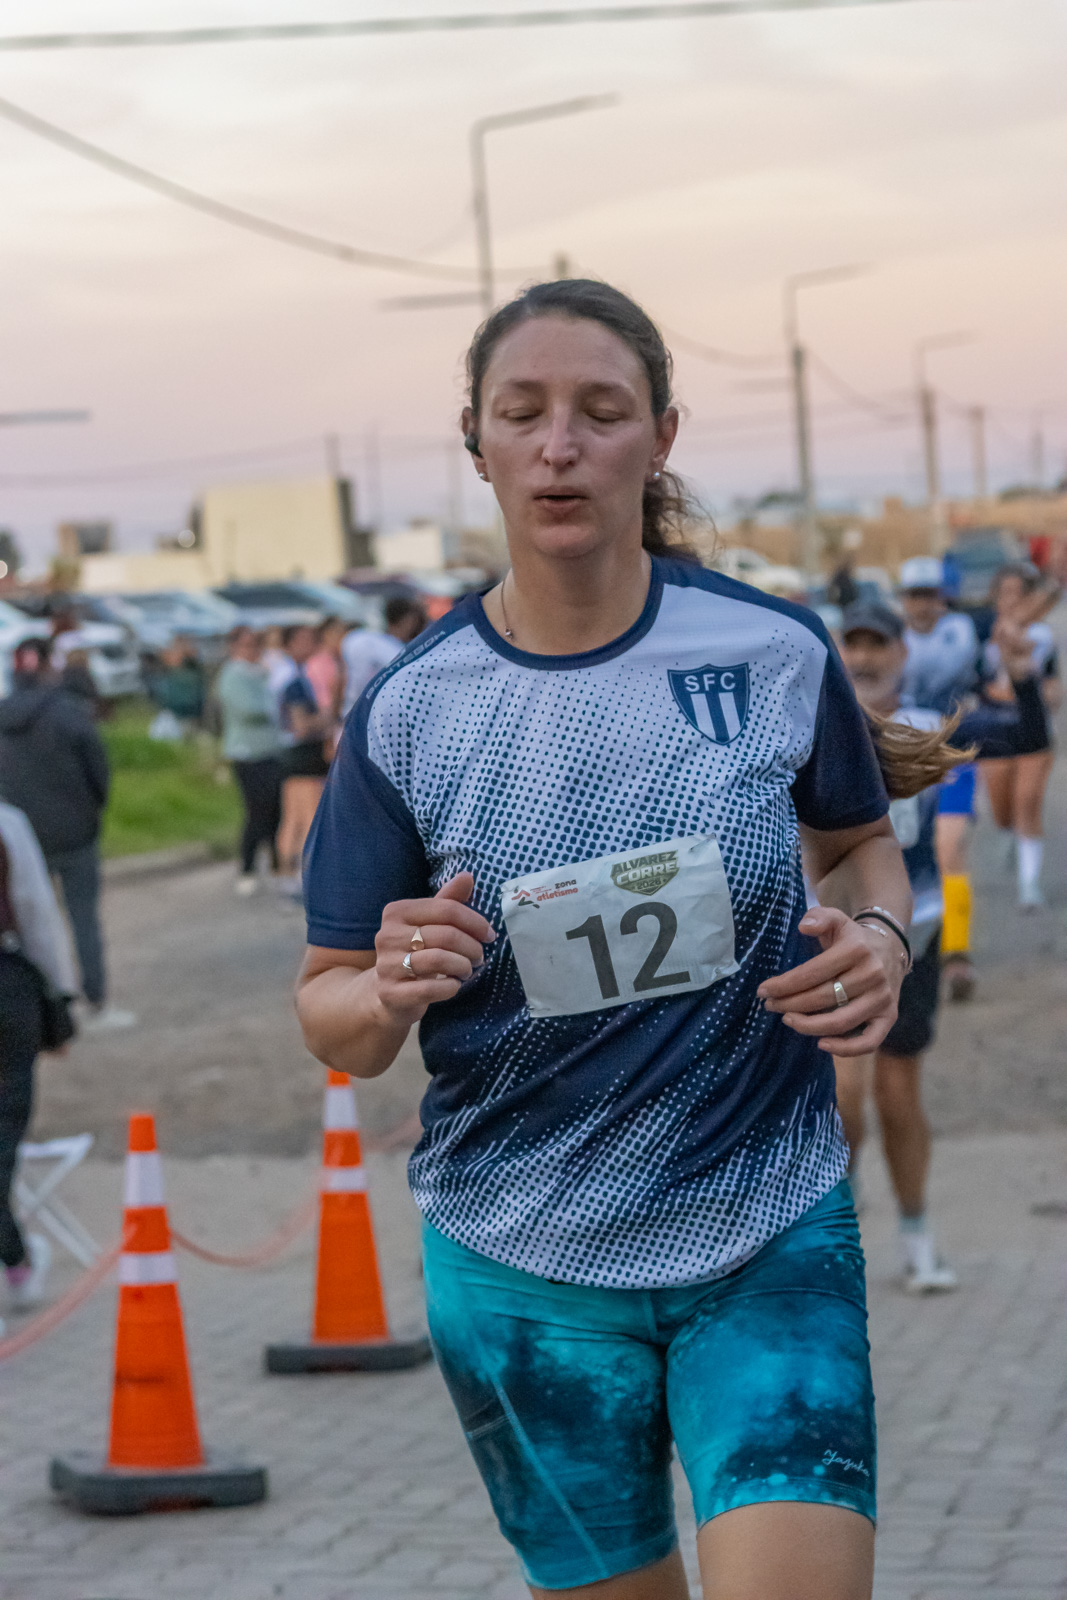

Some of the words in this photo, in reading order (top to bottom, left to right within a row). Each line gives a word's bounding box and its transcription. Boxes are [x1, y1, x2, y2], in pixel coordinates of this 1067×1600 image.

[684, 671, 736, 692] SFC
[612, 850, 677, 875] ALVAREZ
[616, 861, 676, 886] CORRE
[536, 887, 579, 902] atletismo
[554, 879, 577, 889] zona
[565, 901, 691, 1000] 12
